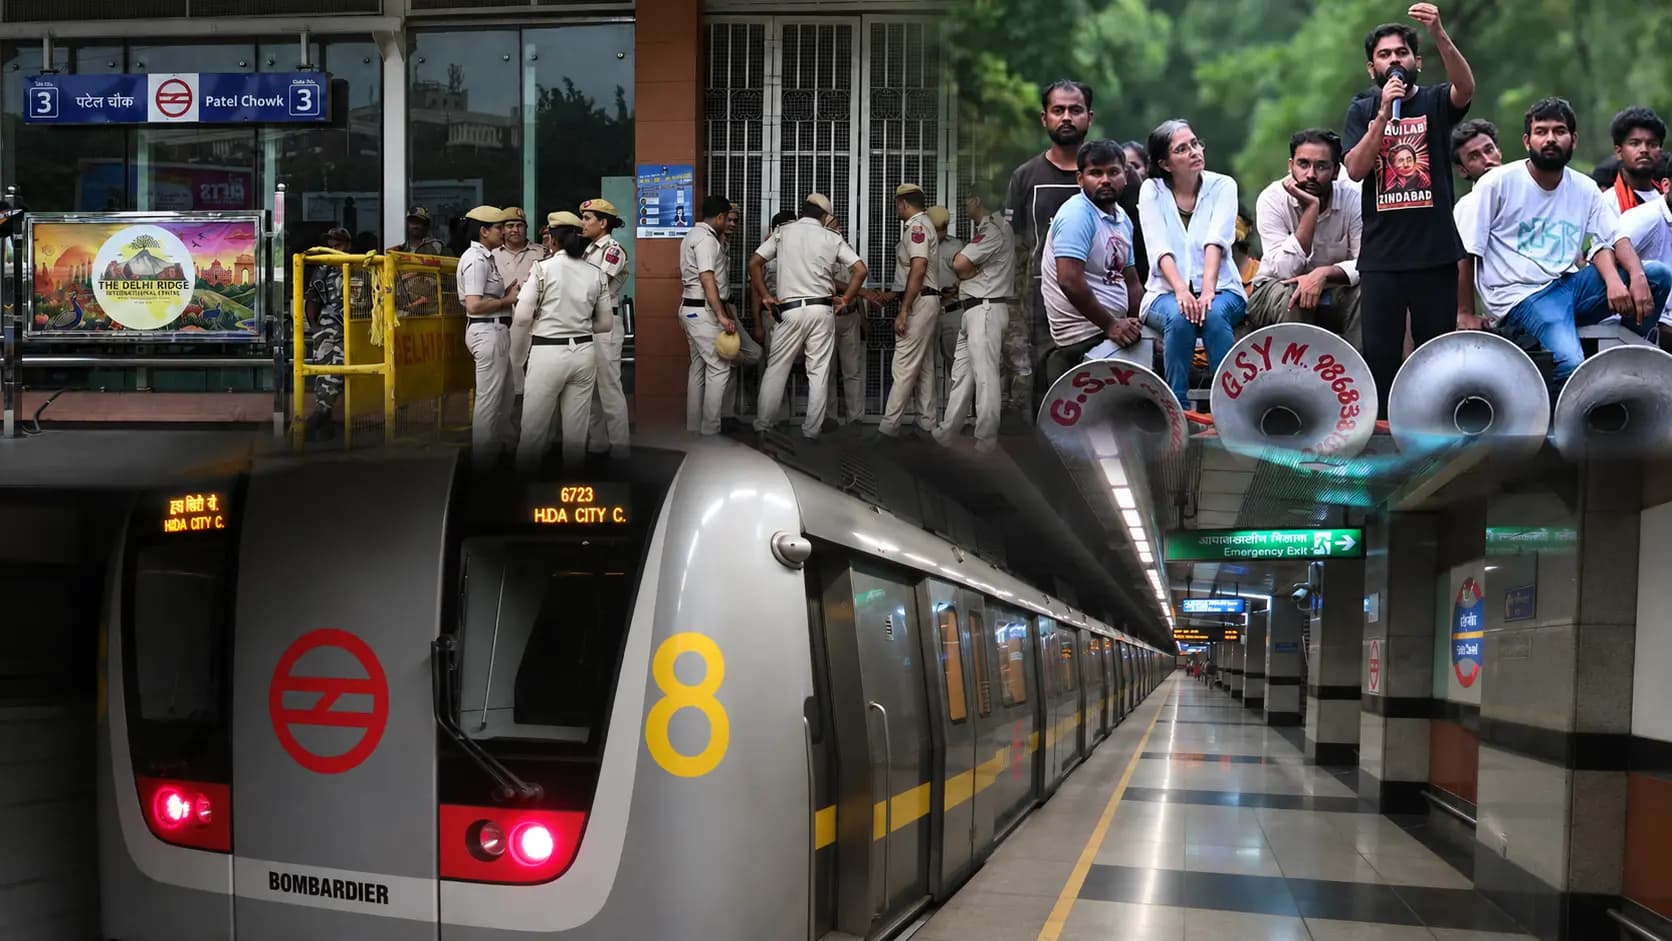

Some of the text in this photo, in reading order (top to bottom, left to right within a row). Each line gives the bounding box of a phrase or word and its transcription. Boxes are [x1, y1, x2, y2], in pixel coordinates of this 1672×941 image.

[37, 91, 52, 113] 3
[75, 92, 134, 108] पटेल चौक
[205, 94, 284, 107] Patel Chowk
[296, 88, 312, 111] 3
[1379, 190, 1432, 204] ZINDABAD
[98, 281, 189, 289] THE DELHI RIDGE
[561, 486, 593, 502] 6723
[191, 516, 211, 530] CITY
[575, 507, 606, 523] CITY
[613, 507, 626, 522] C.
[1224, 546, 1308, 558] Emergency Exit
[645, 631, 730, 777] 8
[269, 871, 388, 904] BOMBARDIER
